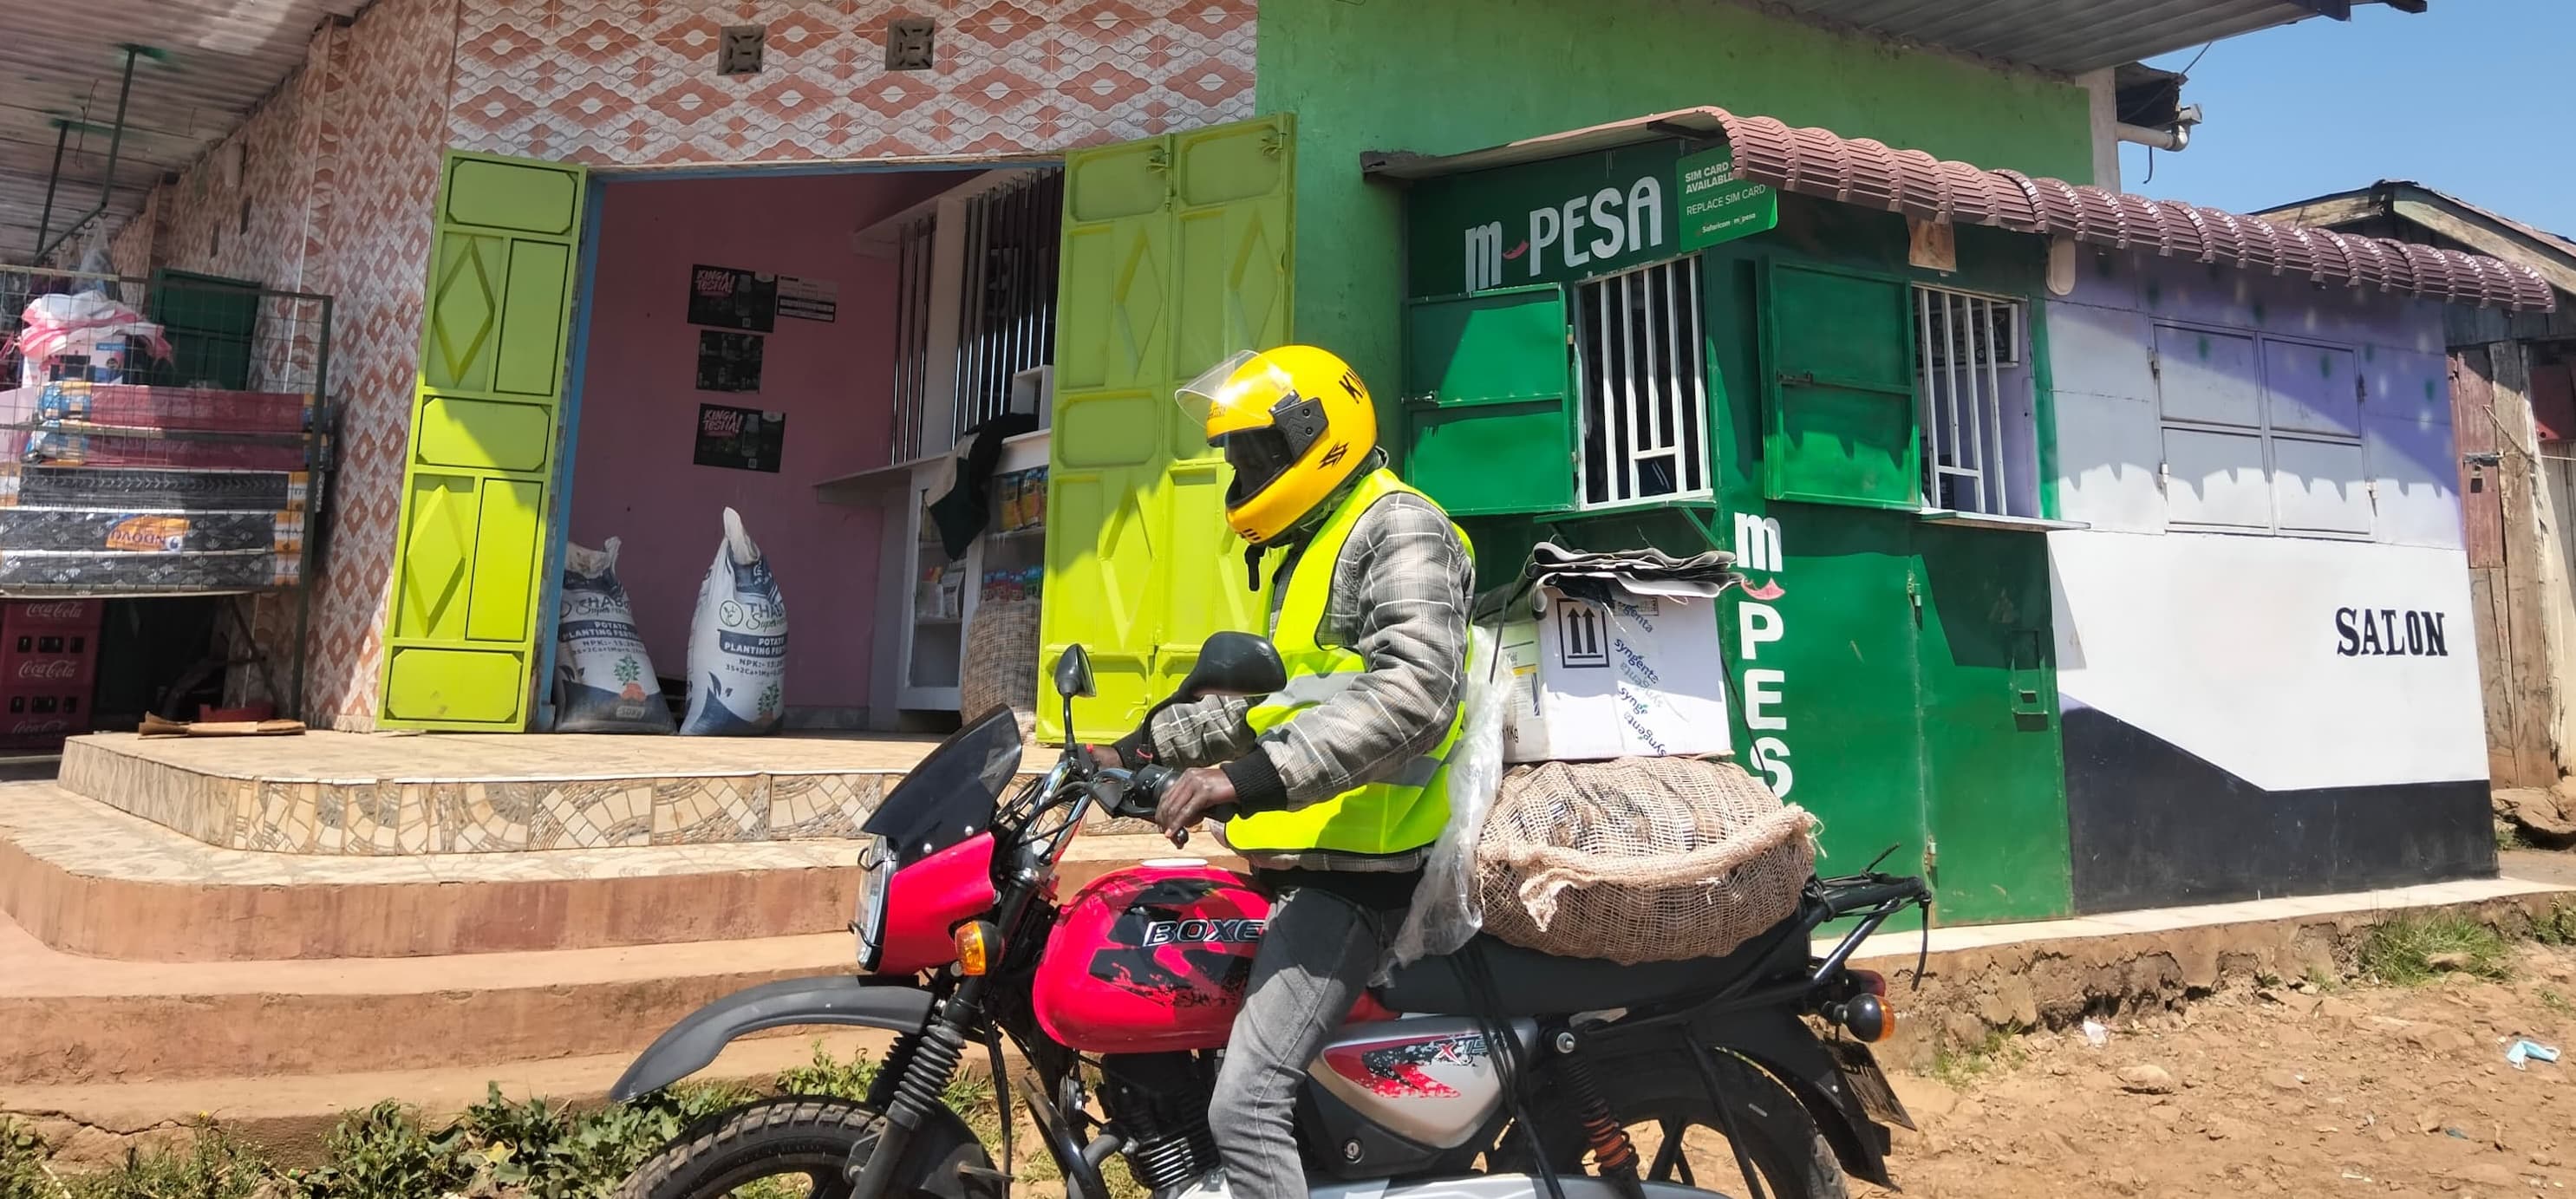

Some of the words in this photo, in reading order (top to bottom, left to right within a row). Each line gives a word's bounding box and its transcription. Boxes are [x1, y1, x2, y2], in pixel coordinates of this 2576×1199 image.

[1685, 169, 1702, 183] SIM
[1703, 161, 1730, 177] CARD
[1686, 196, 1725, 216] REPLACE
[1725, 192, 1740, 205] SIM
[1741, 183, 1767, 199] CARD
[1701, 220, 1731, 234] Safaricom
[696, 270, 730, 281] KINGA
[703, 409, 738, 420] KINGA
[26, 601, 83, 618] Coca-Cola
[2335, 607, 2449, 657] SALON
[724, 641, 771, 655] PLANTING
[18, 659, 79, 679] Coca-Cola
[1614, 638, 1660, 684] syngenta
[1624, 711, 1667, 758] syngenta
[1142, 919, 1266, 948] BOXE
